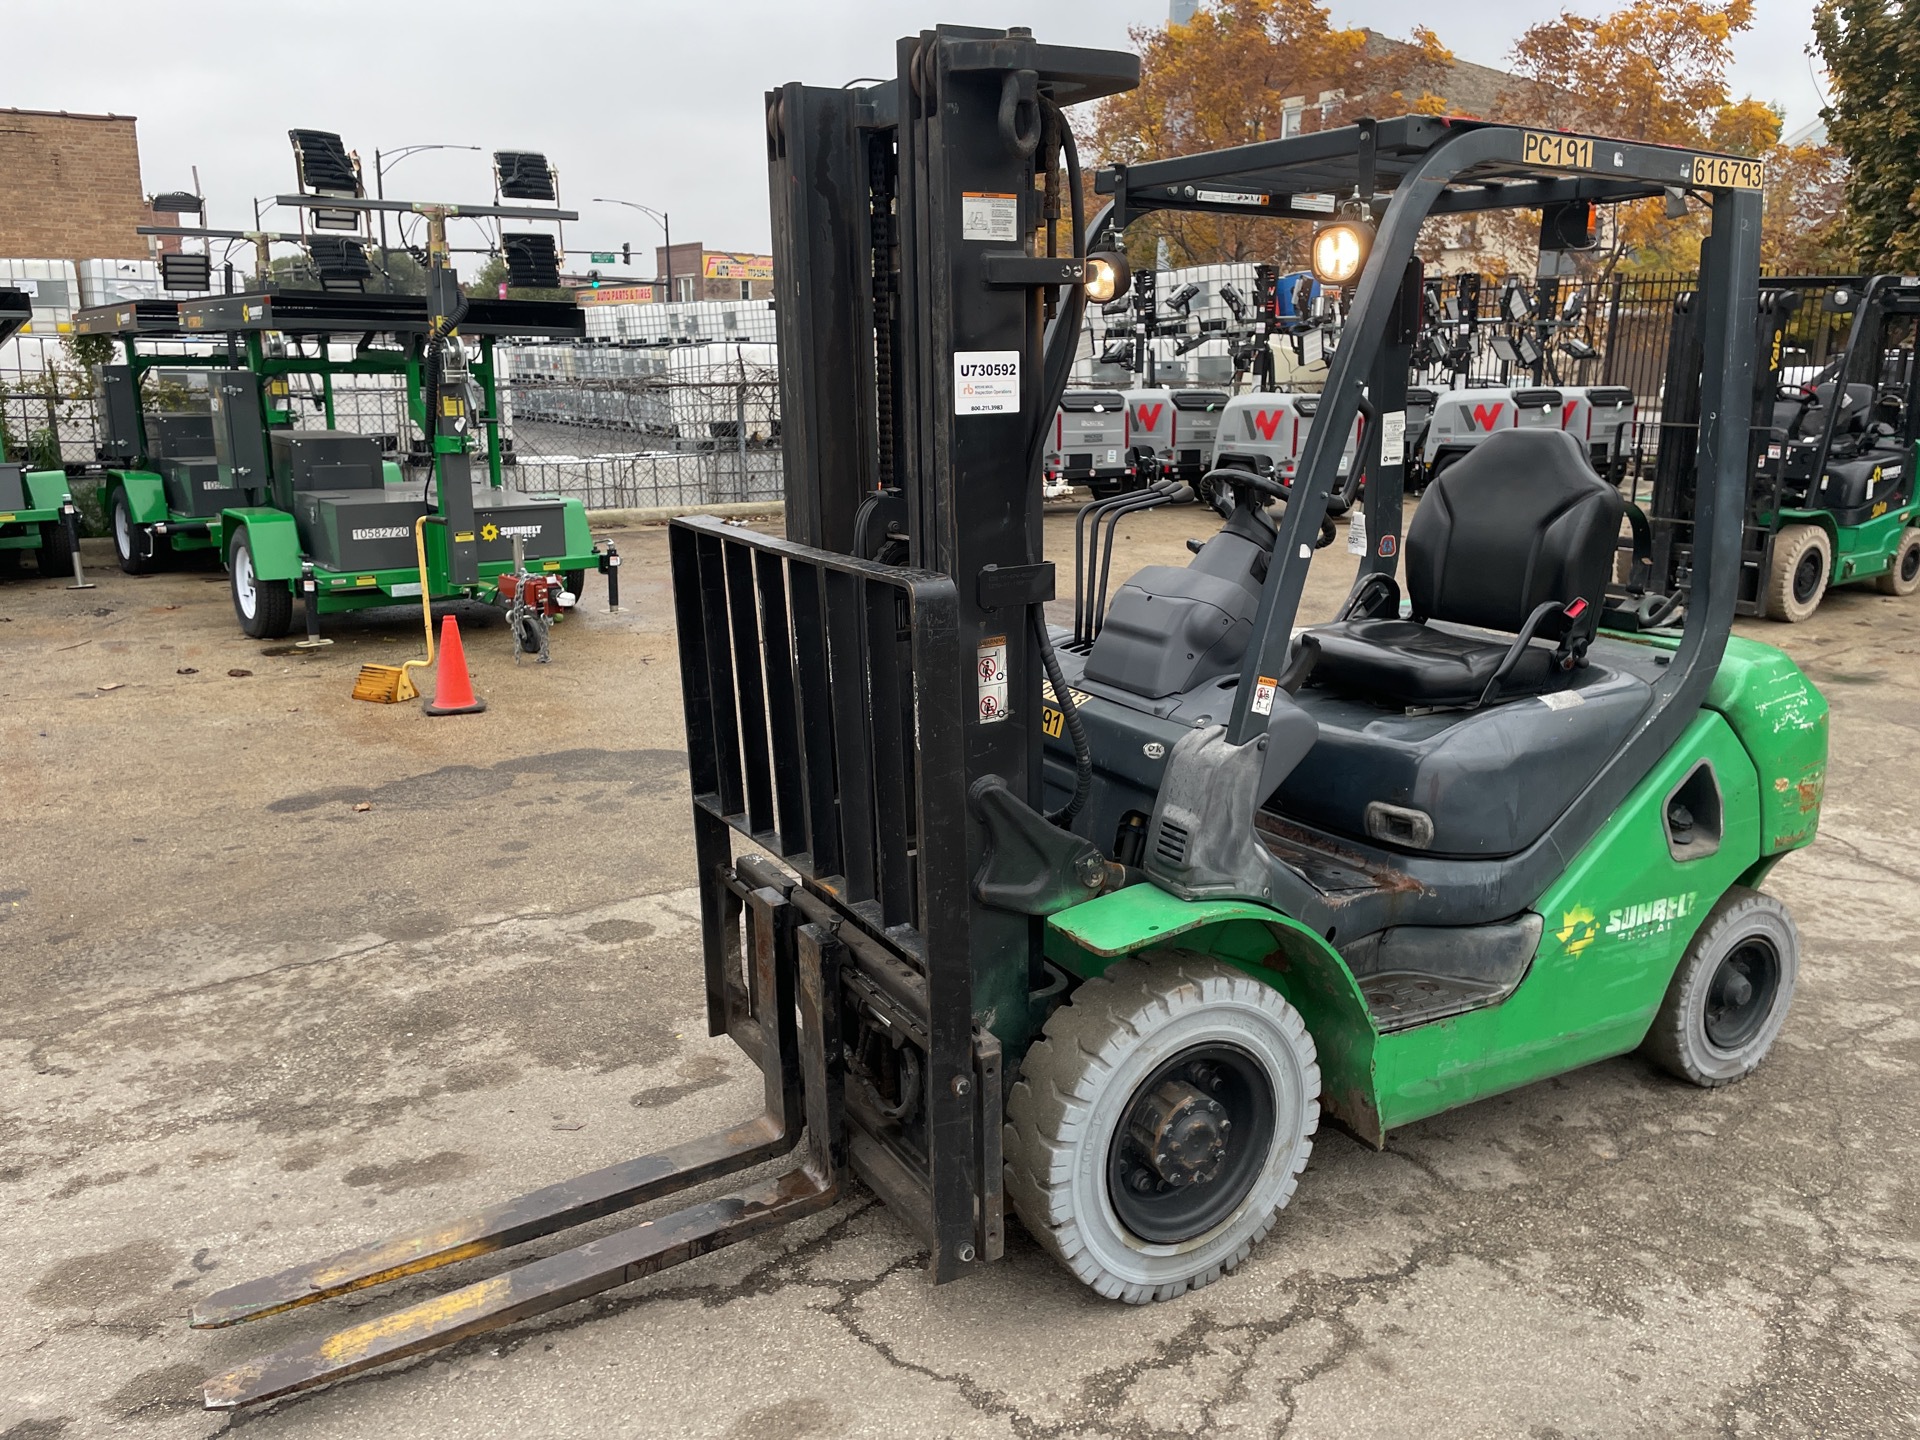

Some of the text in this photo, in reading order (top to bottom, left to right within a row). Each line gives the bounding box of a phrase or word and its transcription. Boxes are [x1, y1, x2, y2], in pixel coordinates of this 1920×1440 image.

[1525, 134, 1589, 167] PC191
[1694, 158, 1763, 188] 616793
[597, 290, 610, 301] AUTO
[611, 289, 629, 301] PARTS
[630, 290, 634, 300] &
[635, 288, 651, 300] TIRES
[960, 363, 1017, 377] U730592
[353, 526, 410, 541] 10582720
[500, 525, 542, 536] SUNBELT
[1605, 891, 1698, 934] SUNBELT
